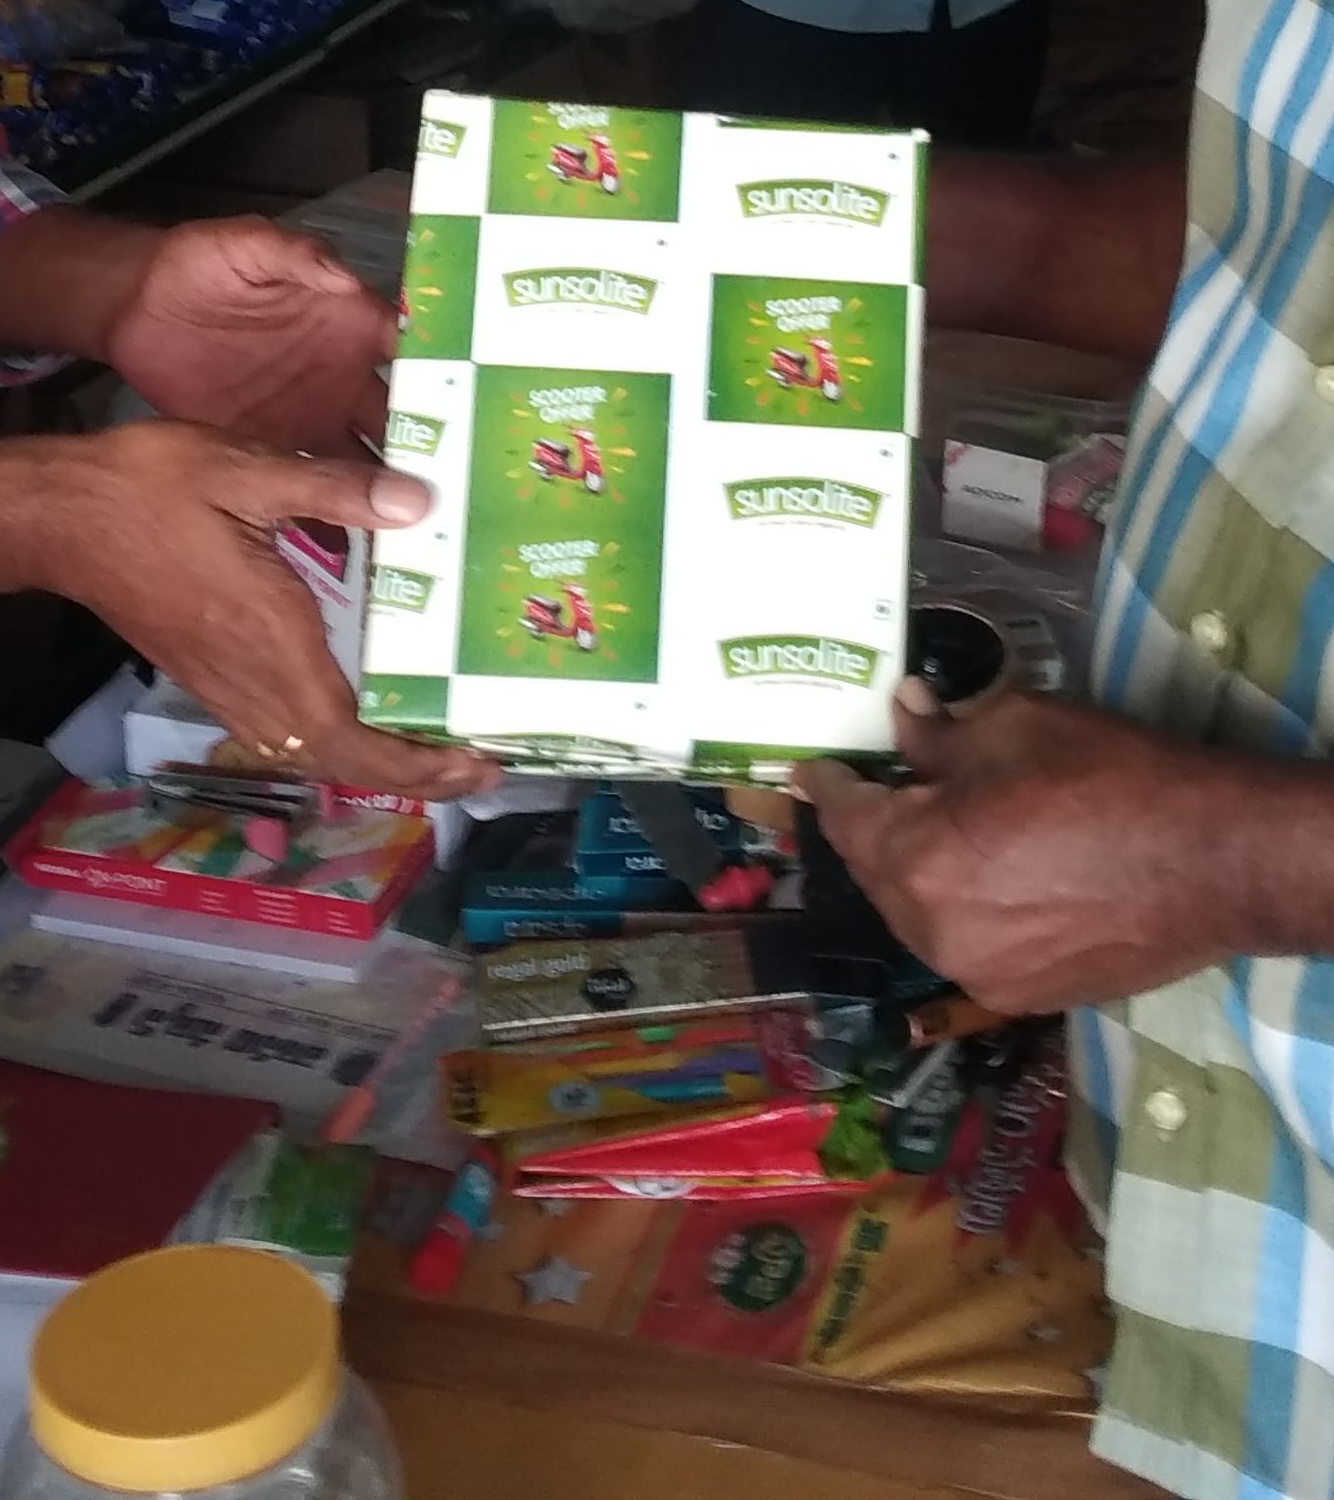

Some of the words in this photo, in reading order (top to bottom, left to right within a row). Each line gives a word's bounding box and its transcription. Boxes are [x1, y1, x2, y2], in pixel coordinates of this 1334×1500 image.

[746, 181, 882, 220] sunsolite
[512, 269, 649, 308] sunsolite
[734, 479, 873, 521] sunsolite
[728, 636, 871, 679] sunsolite
